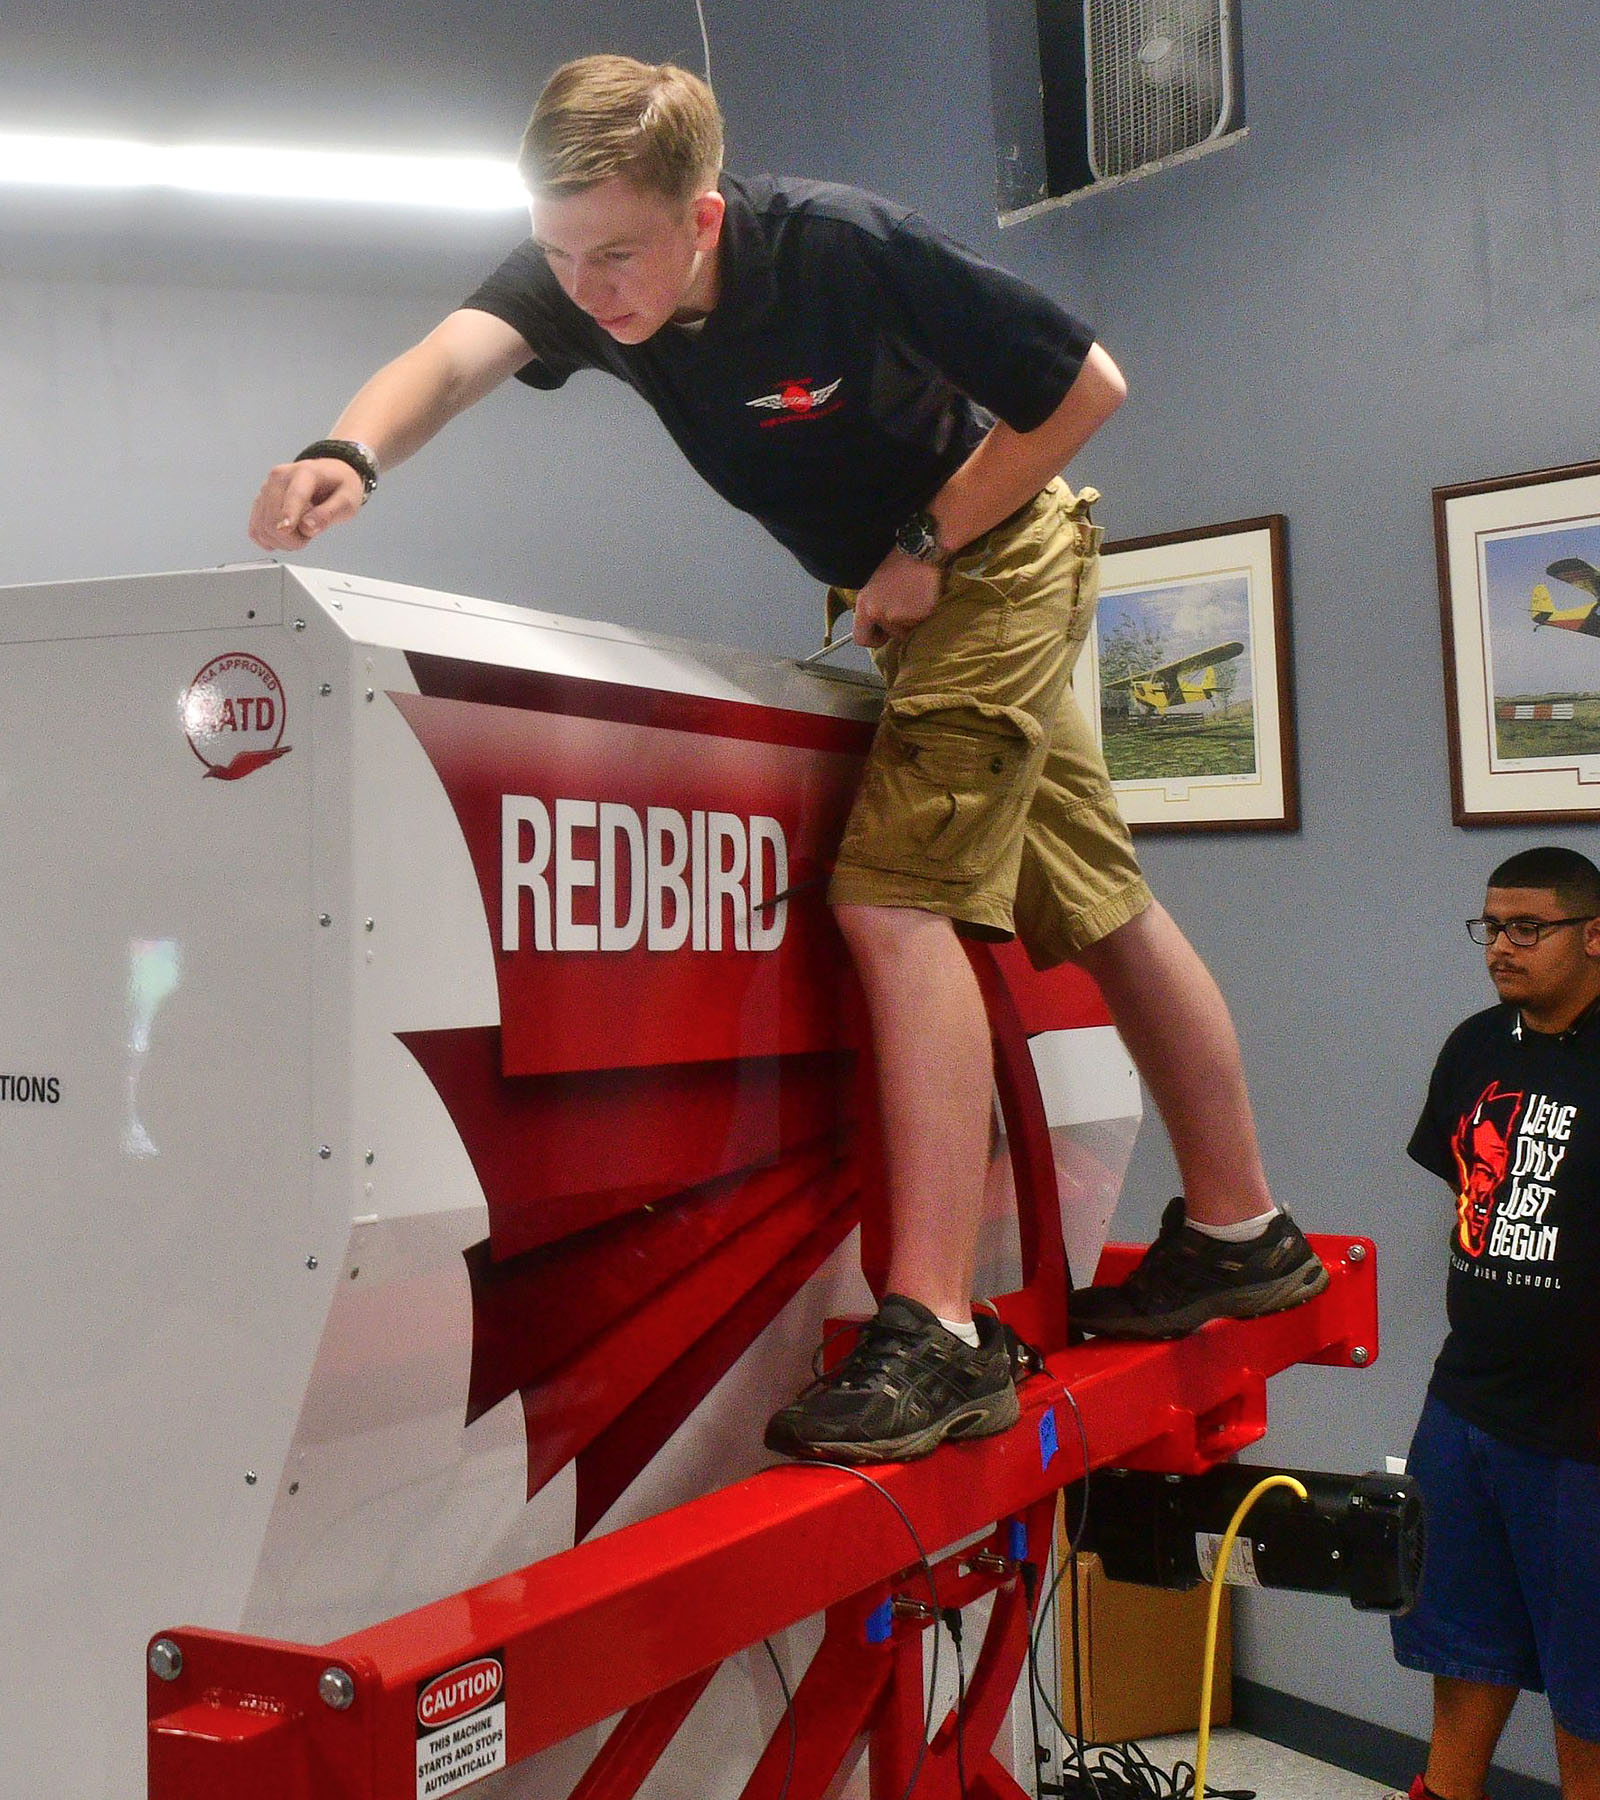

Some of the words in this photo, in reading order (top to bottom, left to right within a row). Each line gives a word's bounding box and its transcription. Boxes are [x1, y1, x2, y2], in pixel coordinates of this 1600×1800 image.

[218, 659, 277, 691] APPROVED
[203, 697, 275, 732] ATD
[501, 793, 790, 952] REDBIRD
[1510, 1135, 1566, 1182] ONLY
[1496, 1176, 1557, 1225] JUST
[1488, 1216, 1560, 1262] BEGUN
[1506, 1271, 1561, 1289] SCHOOL
[422, 1666, 498, 1718] CAUTION
[418, 1753, 453, 1778] STARTS
[454, 1744, 474, 1762] AND
[475, 1729, 503, 1751] STOPS
[429, 1733, 451, 1754] THIS
[452, 1715, 493, 1743] MACHINE
[424, 1750, 497, 1794] AUTOMATICALLY
